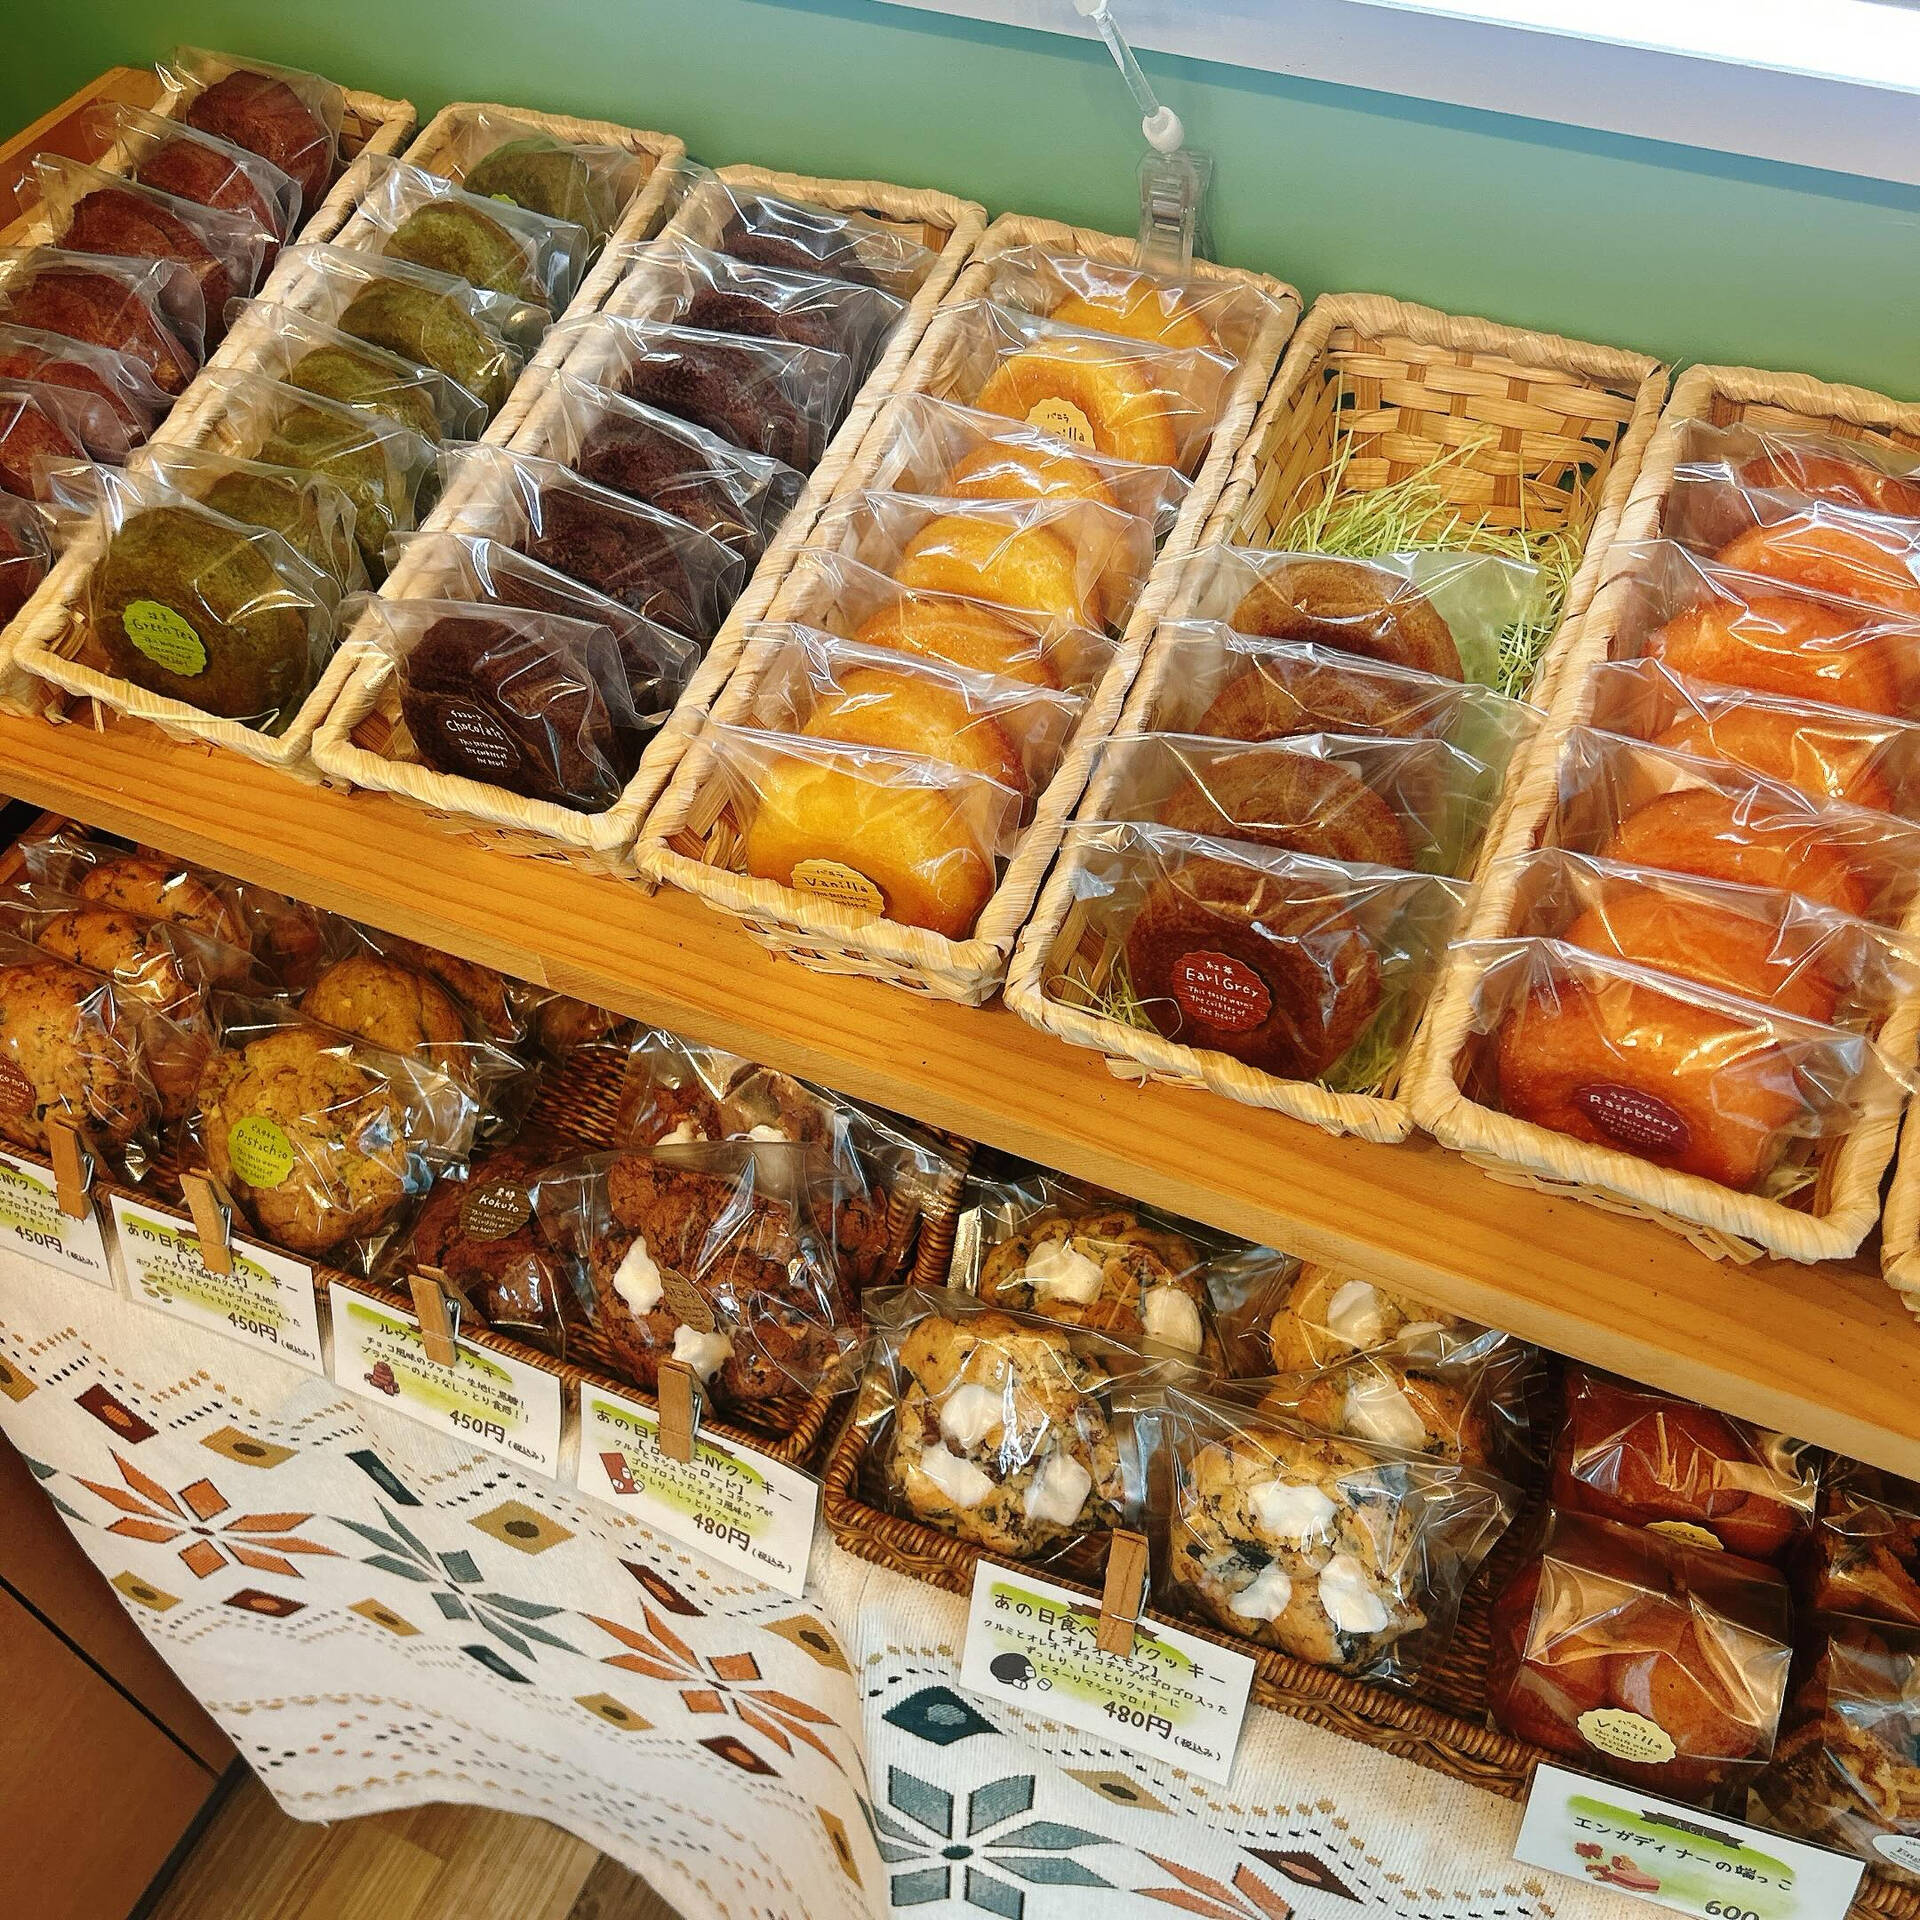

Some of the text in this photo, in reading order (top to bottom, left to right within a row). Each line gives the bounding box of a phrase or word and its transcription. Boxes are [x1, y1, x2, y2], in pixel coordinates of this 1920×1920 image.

[446, 719, 504, 740] Chocolate
[802, 876, 869, 894] Vanilla
[1186, 967, 1259, 998] Earl Grey
[1589, 1094, 1679, 1132] Raspberry
[236, 1129, 288, 1159] Pistachio
[478, 1193, 520, 1214] Kokuto
[16, 1225, 63, 1254] 450円
[228, 1312, 278, 1344] 450円
[449, 1409, 506, 1445] 450円
[692, 1513, 751, 1552] 480円
[994, 1593, 1226, 1684] あの日食べYクッキー
[1102, 1700, 1174, 1741] 480円
[1596, 1718, 1663, 1750] Vanilla
[1574, 1816, 1792, 1891] エンガディナーの端っこ
[1705, 1900, 1760, 1920] 600
